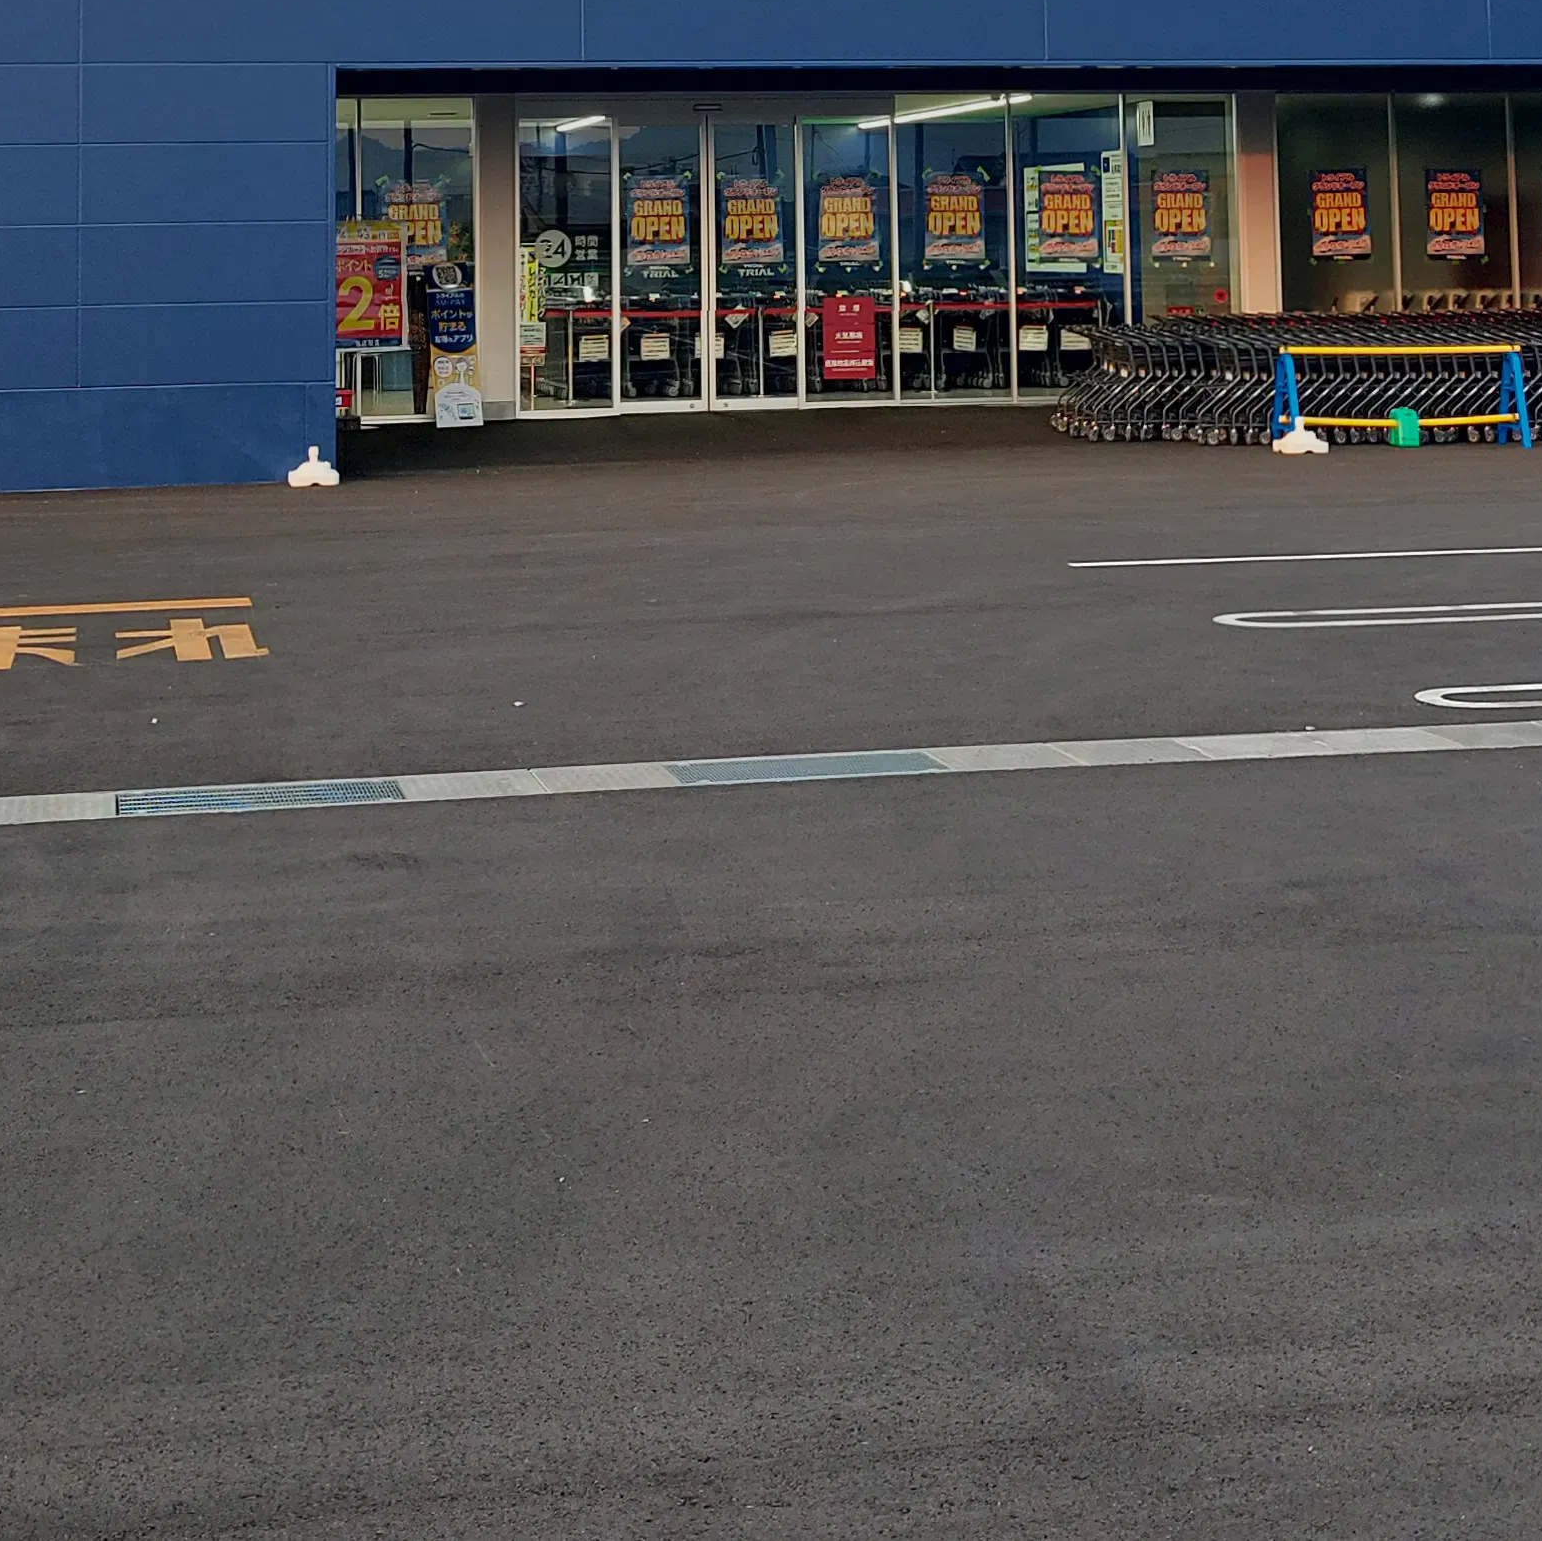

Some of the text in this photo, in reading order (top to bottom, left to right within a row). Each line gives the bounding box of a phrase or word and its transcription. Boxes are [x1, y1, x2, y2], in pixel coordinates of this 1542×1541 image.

[634, 199, 683, 216] GRAND
[727, 199, 775, 214] GRAND
[824, 197, 871, 212] GRAND
[930, 196, 978, 211] GRAND
[1044, 194, 1091, 209] GRAND
[1157, 193, 1203, 208] GRAND
[1316, 192, 1361, 208] GRAND
[1431, 192, 1476, 207] GRAND
[388, 204, 440, 220] GRAND
[1155, 209, 1207, 232] OPEN
[1315, 208, 1366, 231] OPEN
[1429, 208, 1479, 231] OPEN
[631, 216, 685, 240] OPEN
[725, 215, 778, 238] OPEN
[821, 213, 874, 236] OPEN
[928, 212, 981, 234] OPEN
[1041, 210, 1094, 234] OPEN
[406, 220, 442, 245] PEN
[539, 235, 598, 258] 24 時間
[737, 268, 774, 277] TRIAL
